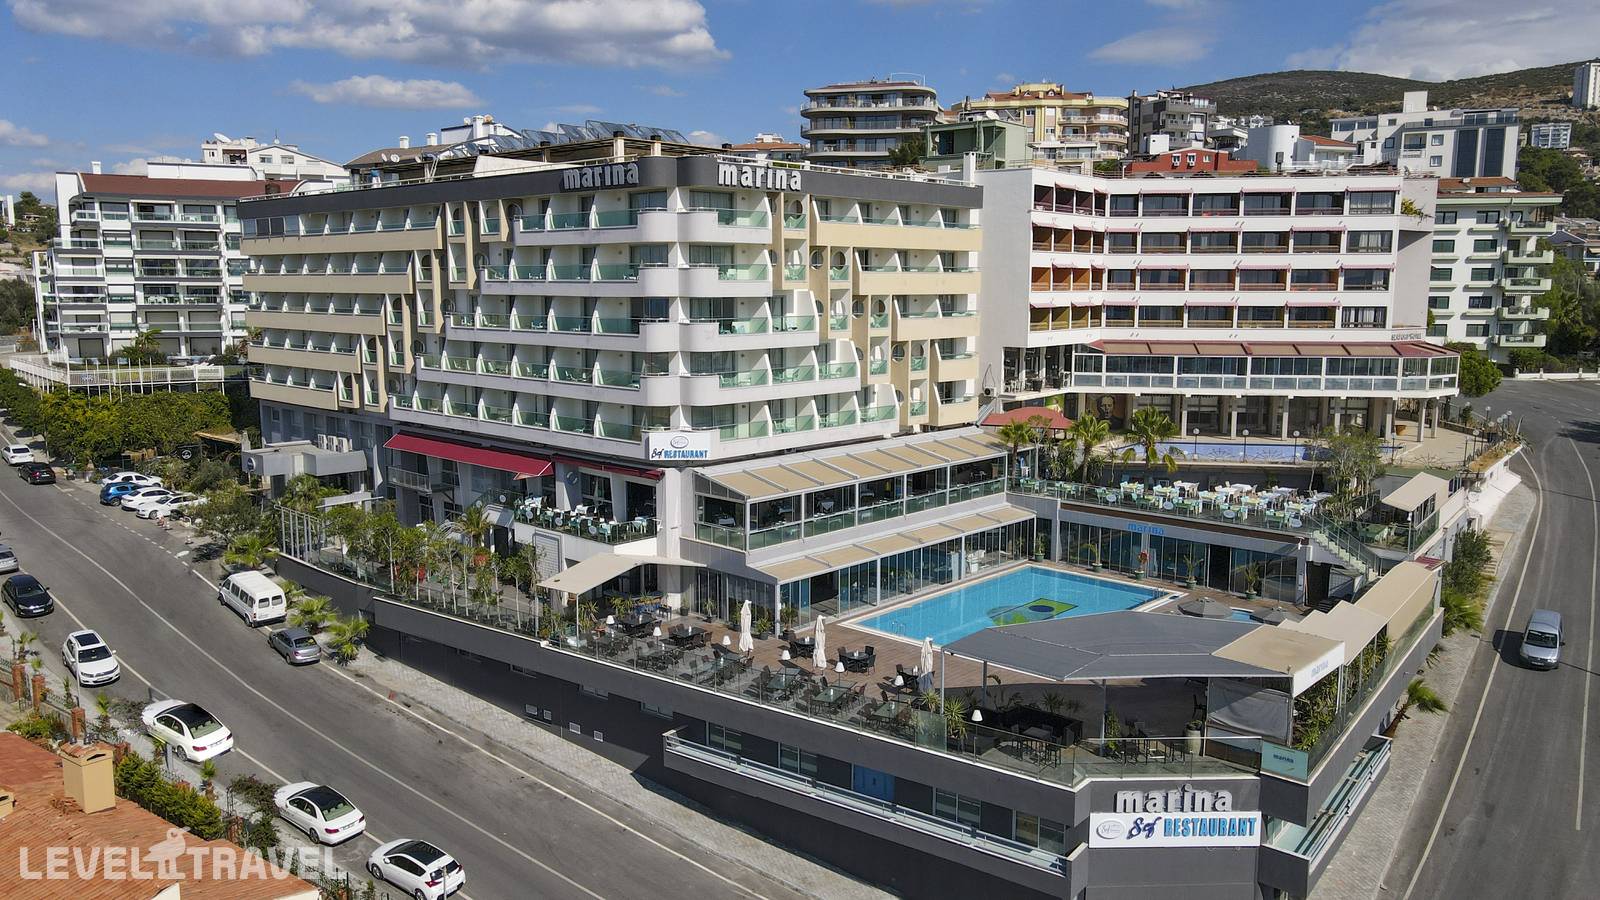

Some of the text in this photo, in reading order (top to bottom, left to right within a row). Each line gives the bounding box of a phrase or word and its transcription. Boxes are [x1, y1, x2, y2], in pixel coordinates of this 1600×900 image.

[563, 162, 639, 190] marina
[718, 163, 802, 192] marina
[664, 450, 708, 459] RESTAURANT
[1128, 523, 1164, 535] marina
[1115, 784, 1233, 813] marina
[1163, 817, 1257, 837] RESTAURANT
